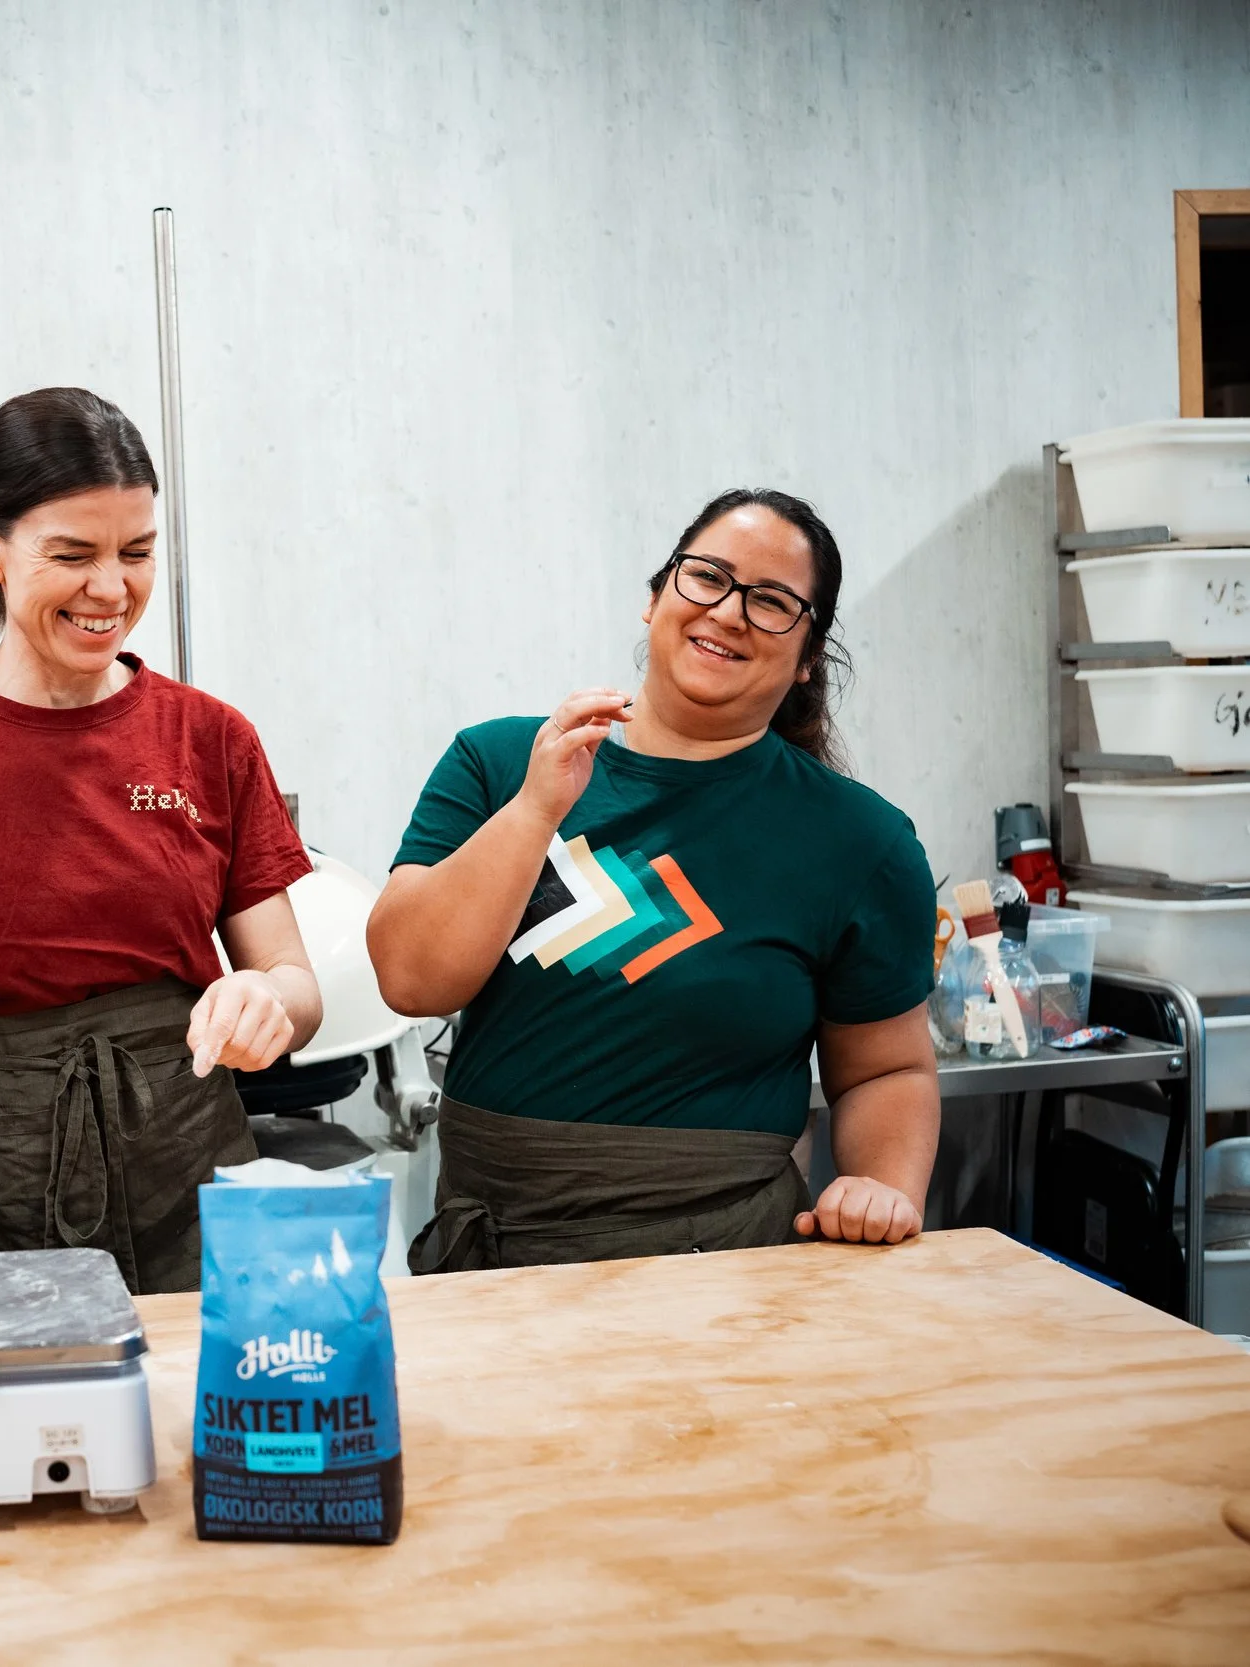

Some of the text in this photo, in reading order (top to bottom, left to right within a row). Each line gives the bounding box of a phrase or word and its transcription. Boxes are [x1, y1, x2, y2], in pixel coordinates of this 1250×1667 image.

[236, 1328, 339, 1380] Holli
[204, 1393, 376, 1432] SIKTET MEL
[205, 1432, 245, 1456] KORN
[204, 1494, 382, 1523] ØKOLOGISK KORN
